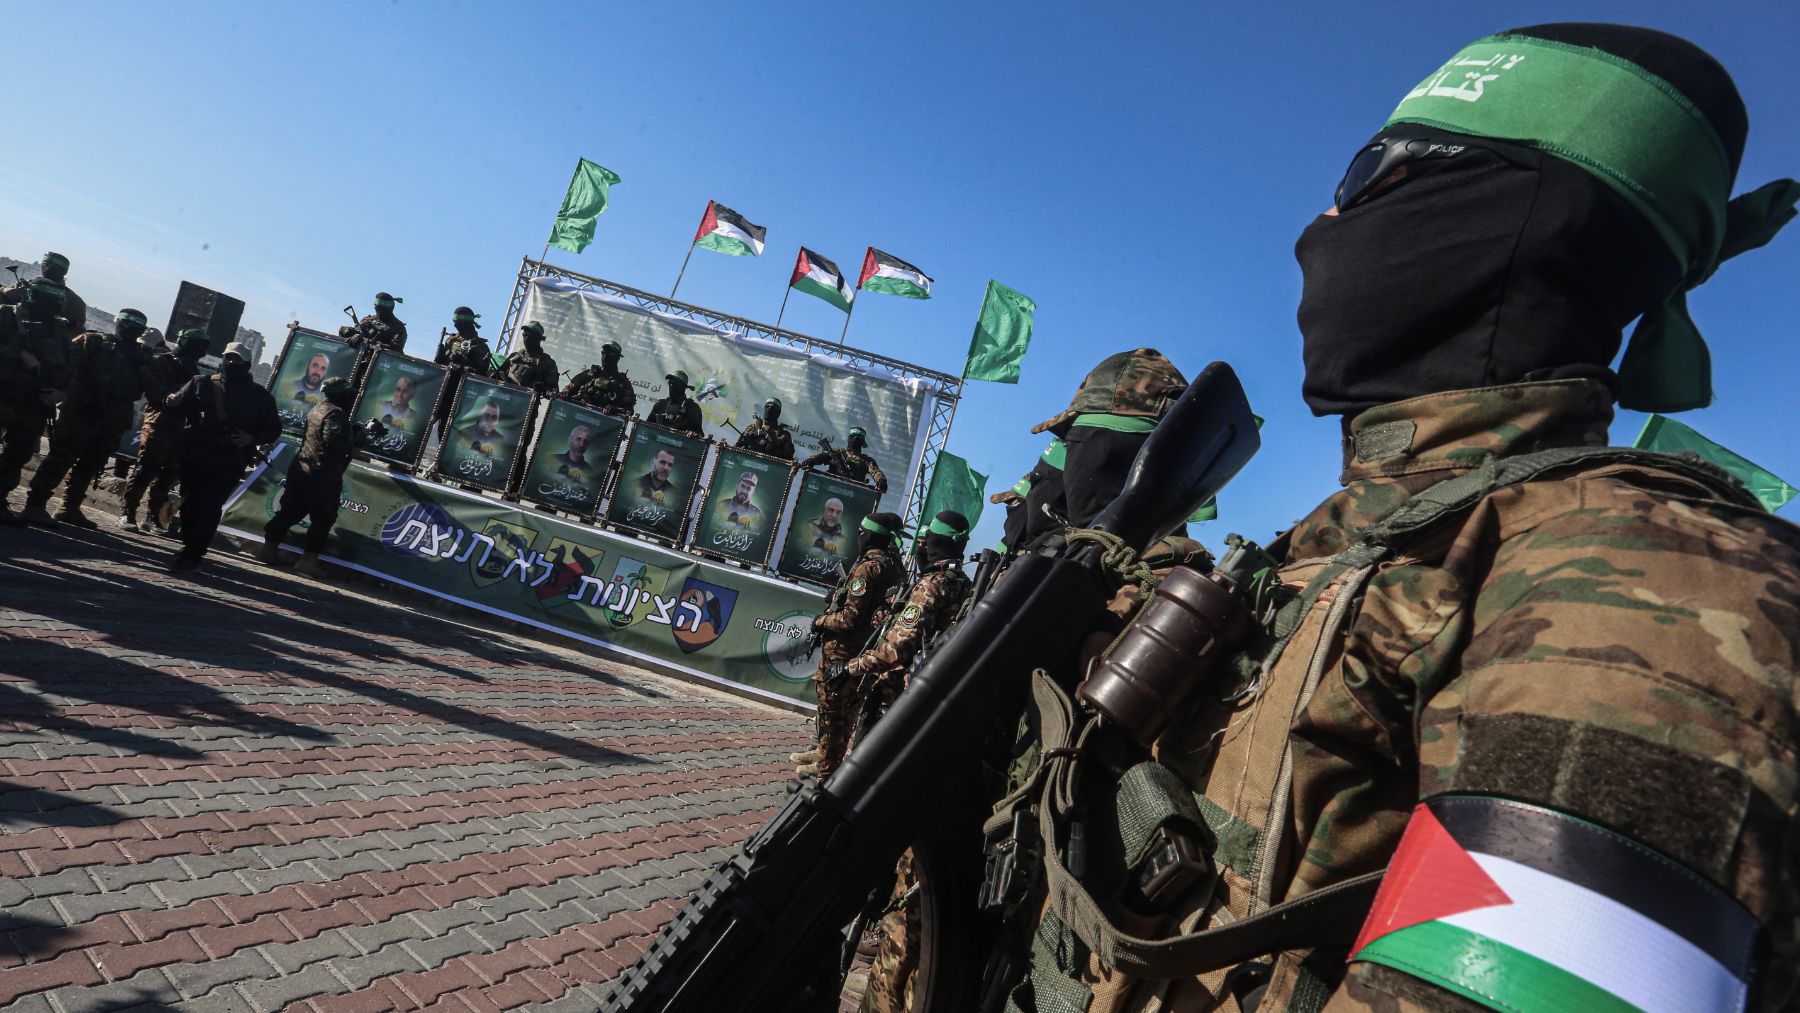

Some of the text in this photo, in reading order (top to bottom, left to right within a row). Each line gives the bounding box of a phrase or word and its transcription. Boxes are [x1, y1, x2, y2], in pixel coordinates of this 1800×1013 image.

[1429, 144, 1465, 153] POLICE
[630, 379, 651, 389] تنتص
[392, 518, 496, 568] תנצח
[501, 547, 555, 588] לא
[566, 574, 704, 634] הציונות
[786, 626, 803, 639] לא
